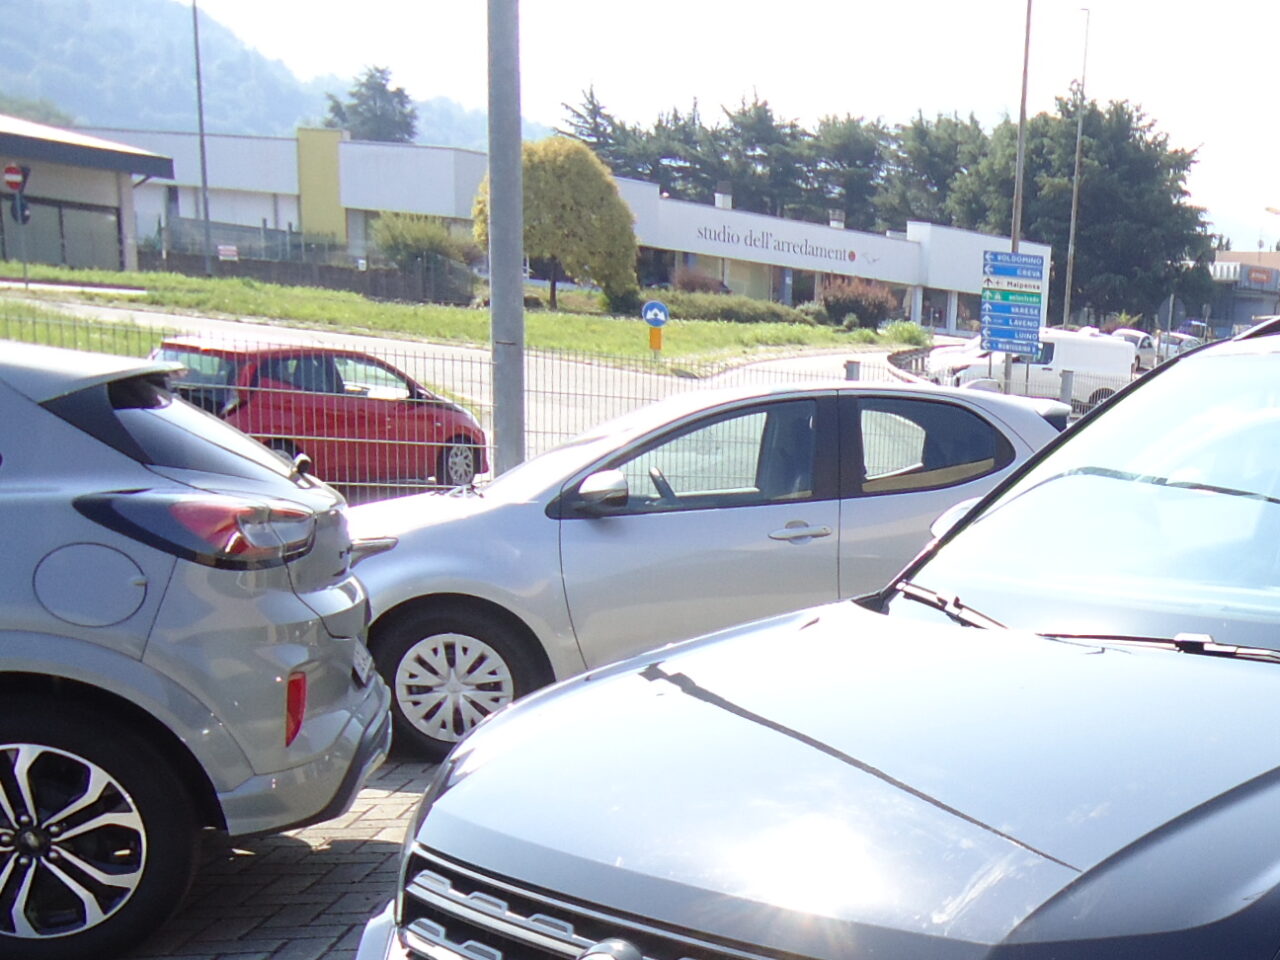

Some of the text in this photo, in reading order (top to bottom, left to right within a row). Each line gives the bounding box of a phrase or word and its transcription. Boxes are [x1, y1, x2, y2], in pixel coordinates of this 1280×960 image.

[697, 225, 740, 244] studio
[997, 254, 1042, 265] VOLDOMINO
[1016, 268, 1041, 277] CREVA
[1006, 281, 1041, 290] Malpensa
[1011, 307, 1039, 315] VARESE
[1008, 317, 1038, 327] LAVENO
[1014, 331, 1038, 340] LUINO
